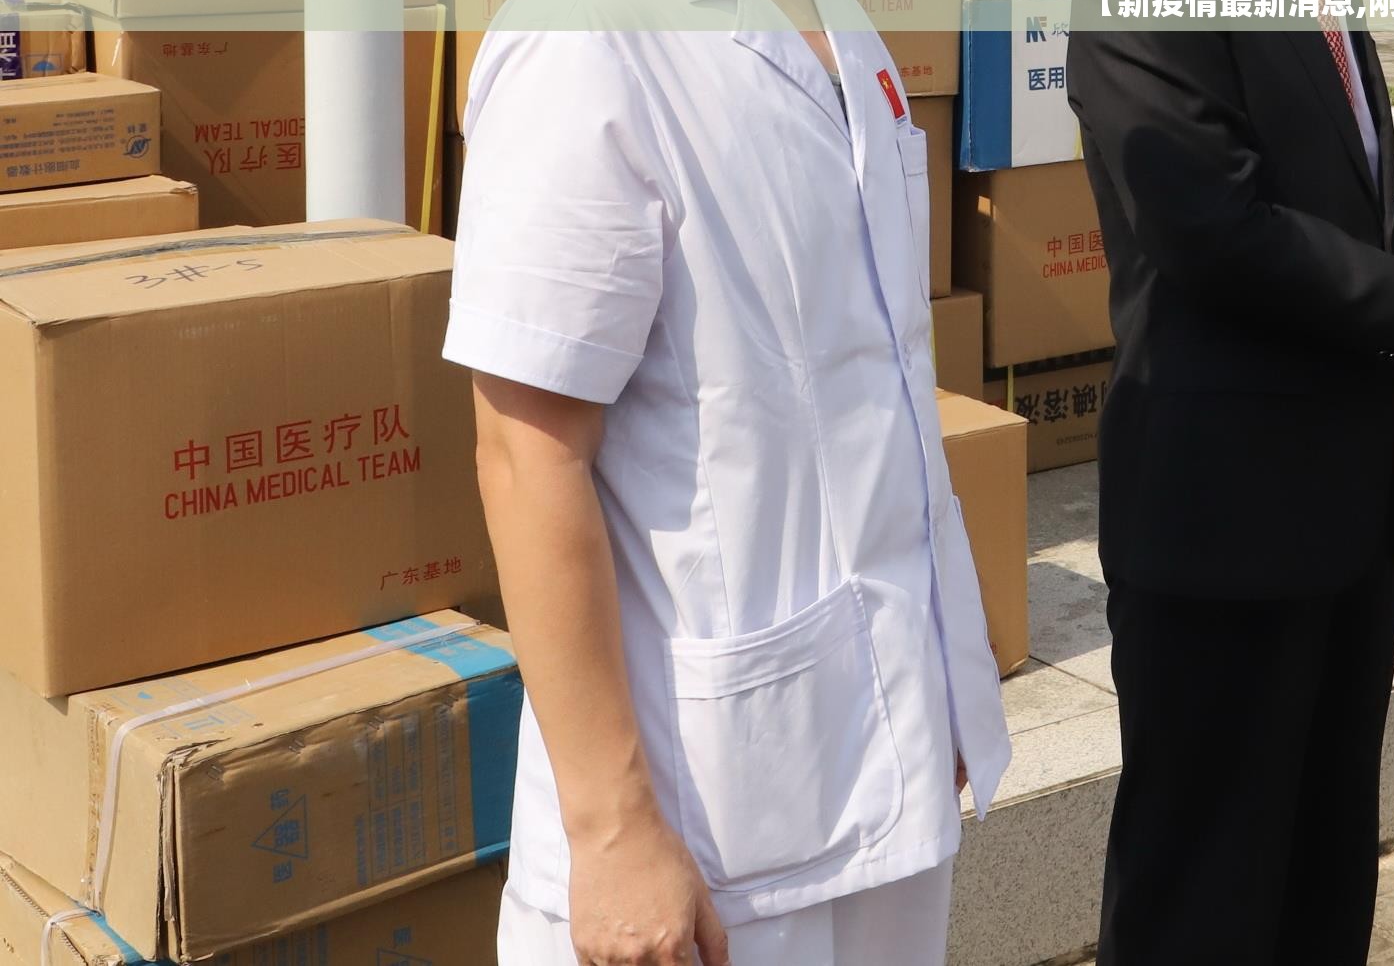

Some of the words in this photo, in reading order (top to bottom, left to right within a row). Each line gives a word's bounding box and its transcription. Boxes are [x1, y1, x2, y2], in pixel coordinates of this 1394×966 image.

[161, 41, 230, 58] 广东基地
[1027, 67, 1065, 92] 医用
[194, 121, 243, 142] TEAM
[203, 141, 302, 174] 医疗队
[1042, 260, 1074, 279] CHINA
[1014, 381, 1107, 427] 碘溶液
[173, 404, 410, 482] 中国医疗队
[164, 481, 239, 520] CHINA
[246, 462, 350, 505] MEDICAL
[357, 445, 422, 482] TEAM
[380, 556, 463, 591] 广东基地
